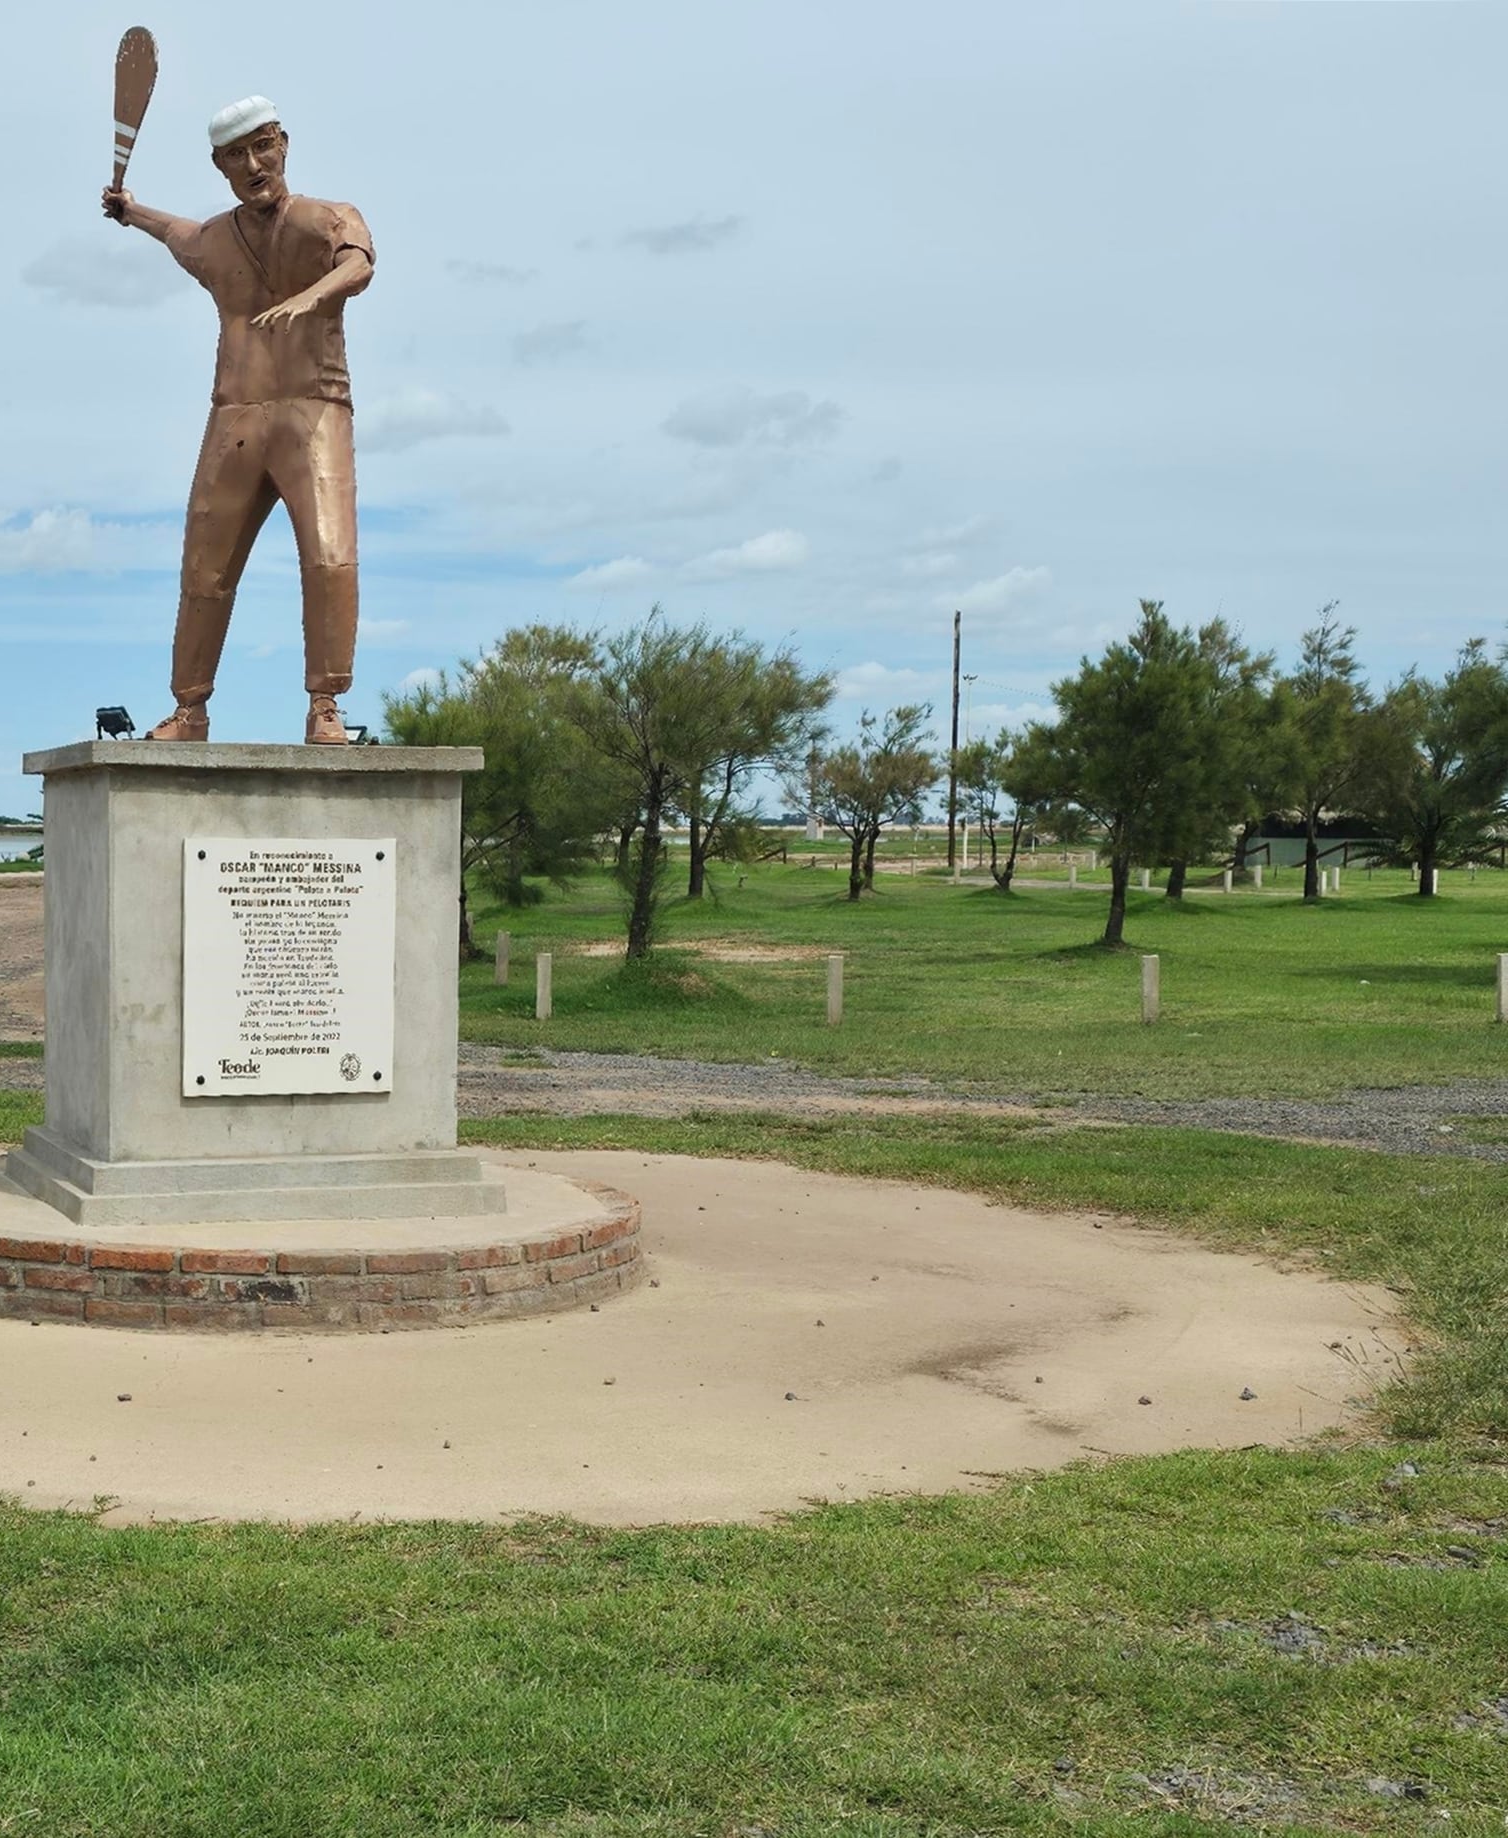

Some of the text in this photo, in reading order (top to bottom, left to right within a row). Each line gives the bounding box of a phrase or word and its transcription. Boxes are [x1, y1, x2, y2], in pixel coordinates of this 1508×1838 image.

[250, 851, 260, 859] En
[220, 862, 362, 873] OSCAR "MANCO" MESSINA
[279, 876, 284, 884] y
[331, 875, 344, 883] del
[270, 899, 293, 907] PARA
[294, 899, 306, 907] UN
[308, 899, 351, 907] PELOTARIS
[250, 1033, 261, 1041] de
[263, 1033, 308, 1043] Septiembre
[310, 1033, 320, 1041] de
[322, 1032, 341, 1041] 2022
[218, 1058, 261, 1075] Teode
